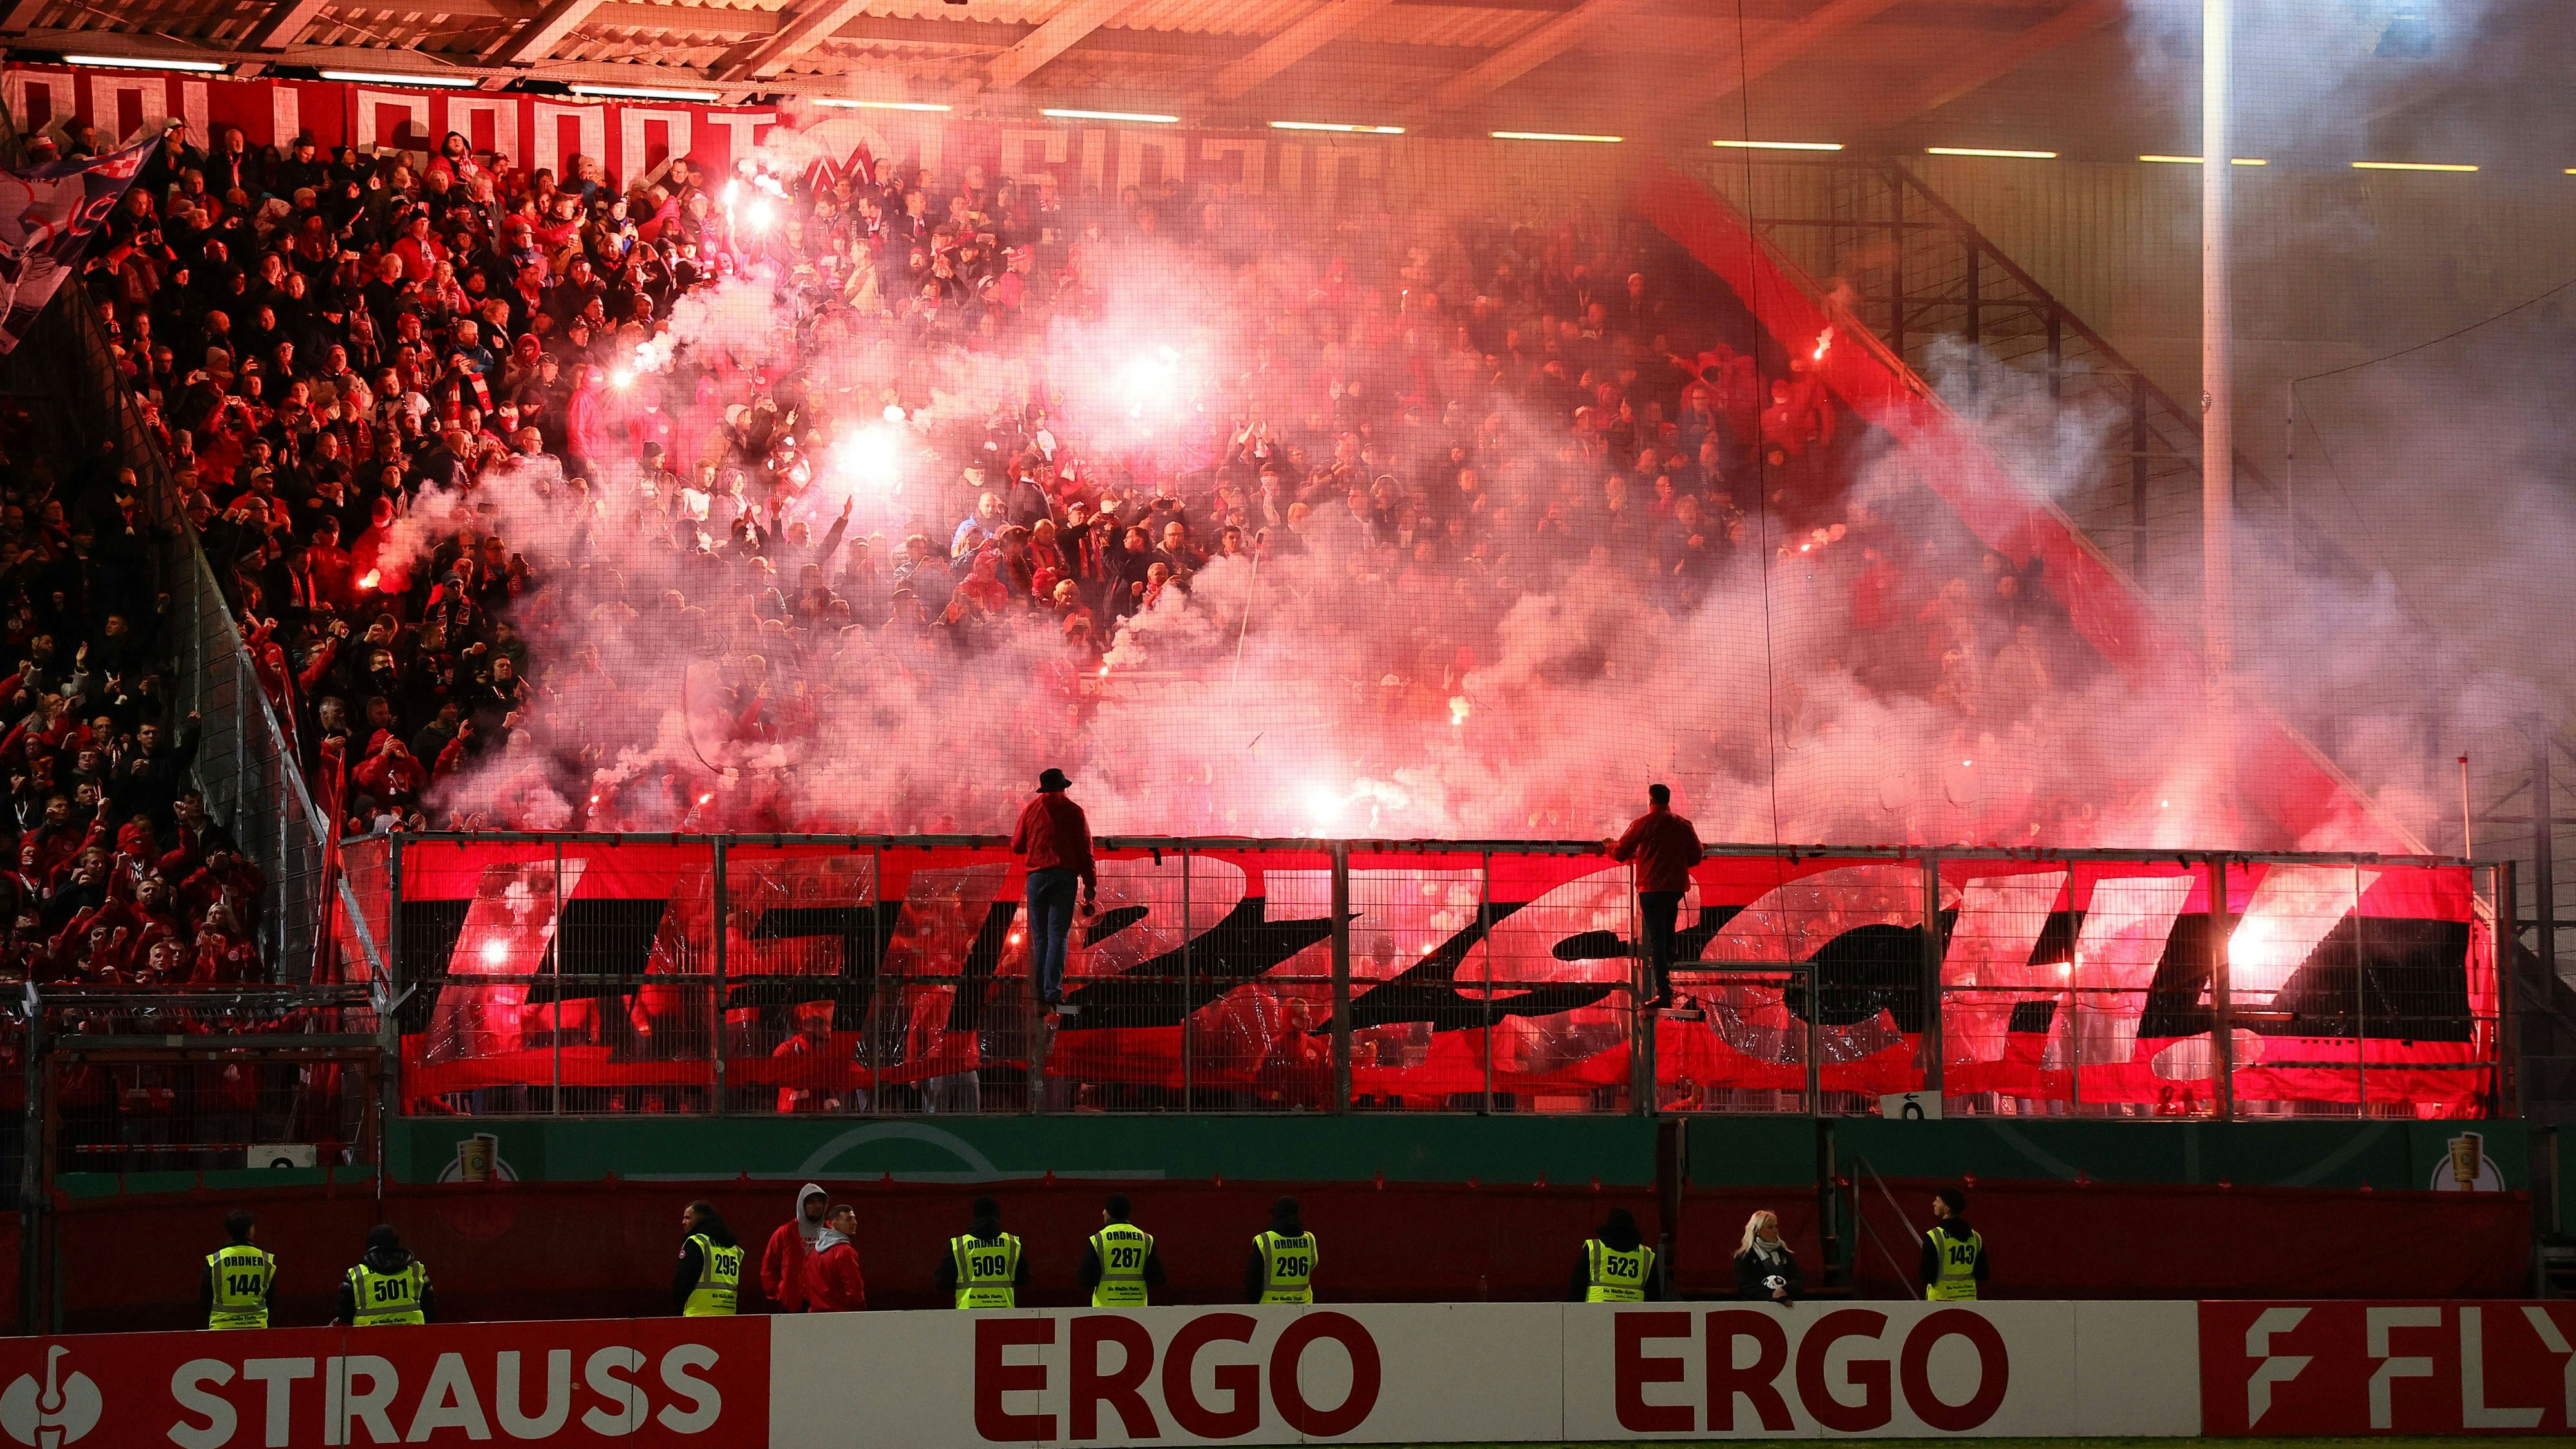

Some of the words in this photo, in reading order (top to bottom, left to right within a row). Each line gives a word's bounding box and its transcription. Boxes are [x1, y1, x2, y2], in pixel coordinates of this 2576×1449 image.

[967, 1238, 1005, 1249] ORDNER
[1106, 1231, 1143, 1241] ORDNER
[1274, 1238, 1309, 1249] ORDNER
[223, 1256, 263, 1267] ORDNER
[715, 1253, 737, 1276] 295
[1111, 1247, 1142, 1269] 287
[1948, 1244, 1975, 1265] 143
[972, 1255, 1005, 1277] 509
[1276, 1256, 1309, 1277] 296
[1607, 1255, 1639, 1278] 523
[227, 1274, 260, 1296] 144
[374, 1278, 408, 1302] 501
[974, 1311, 1381, 1443] ERGO
[1614, 1308, 2009, 1432] ERGO
[166, 1343, 722, 1449] STRAUSS
